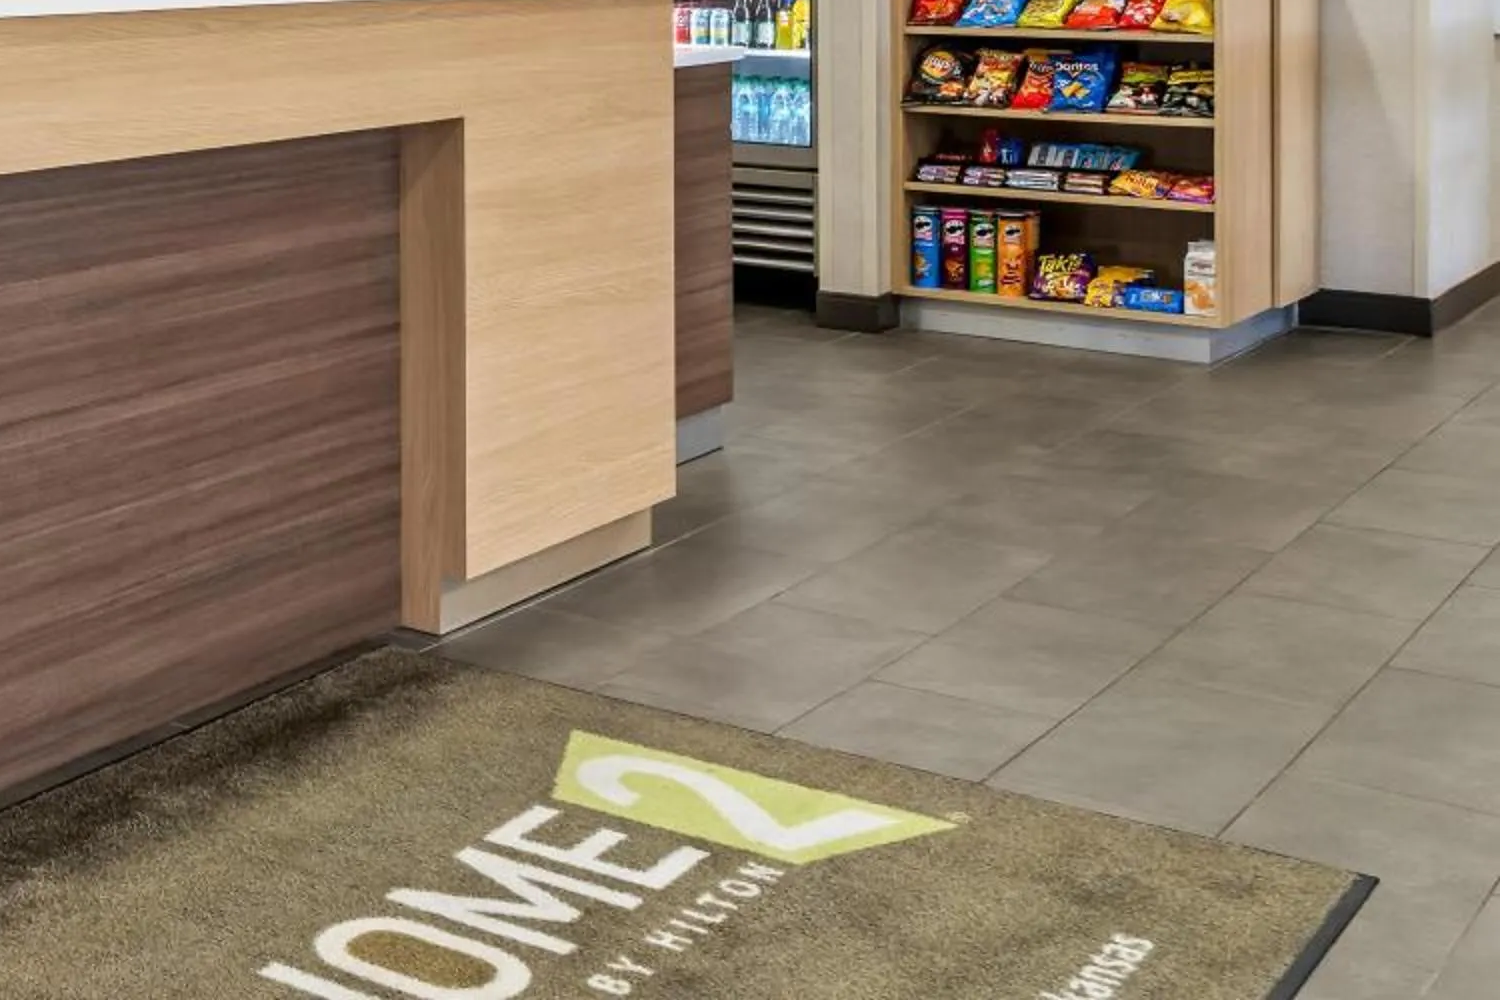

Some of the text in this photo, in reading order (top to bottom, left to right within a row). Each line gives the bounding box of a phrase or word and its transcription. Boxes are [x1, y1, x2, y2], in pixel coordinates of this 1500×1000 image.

[257, 805, 710, 1000] OME
[587, 860, 785, 996] BY HILTON
[1039, 933, 1155, 1000] ansas
